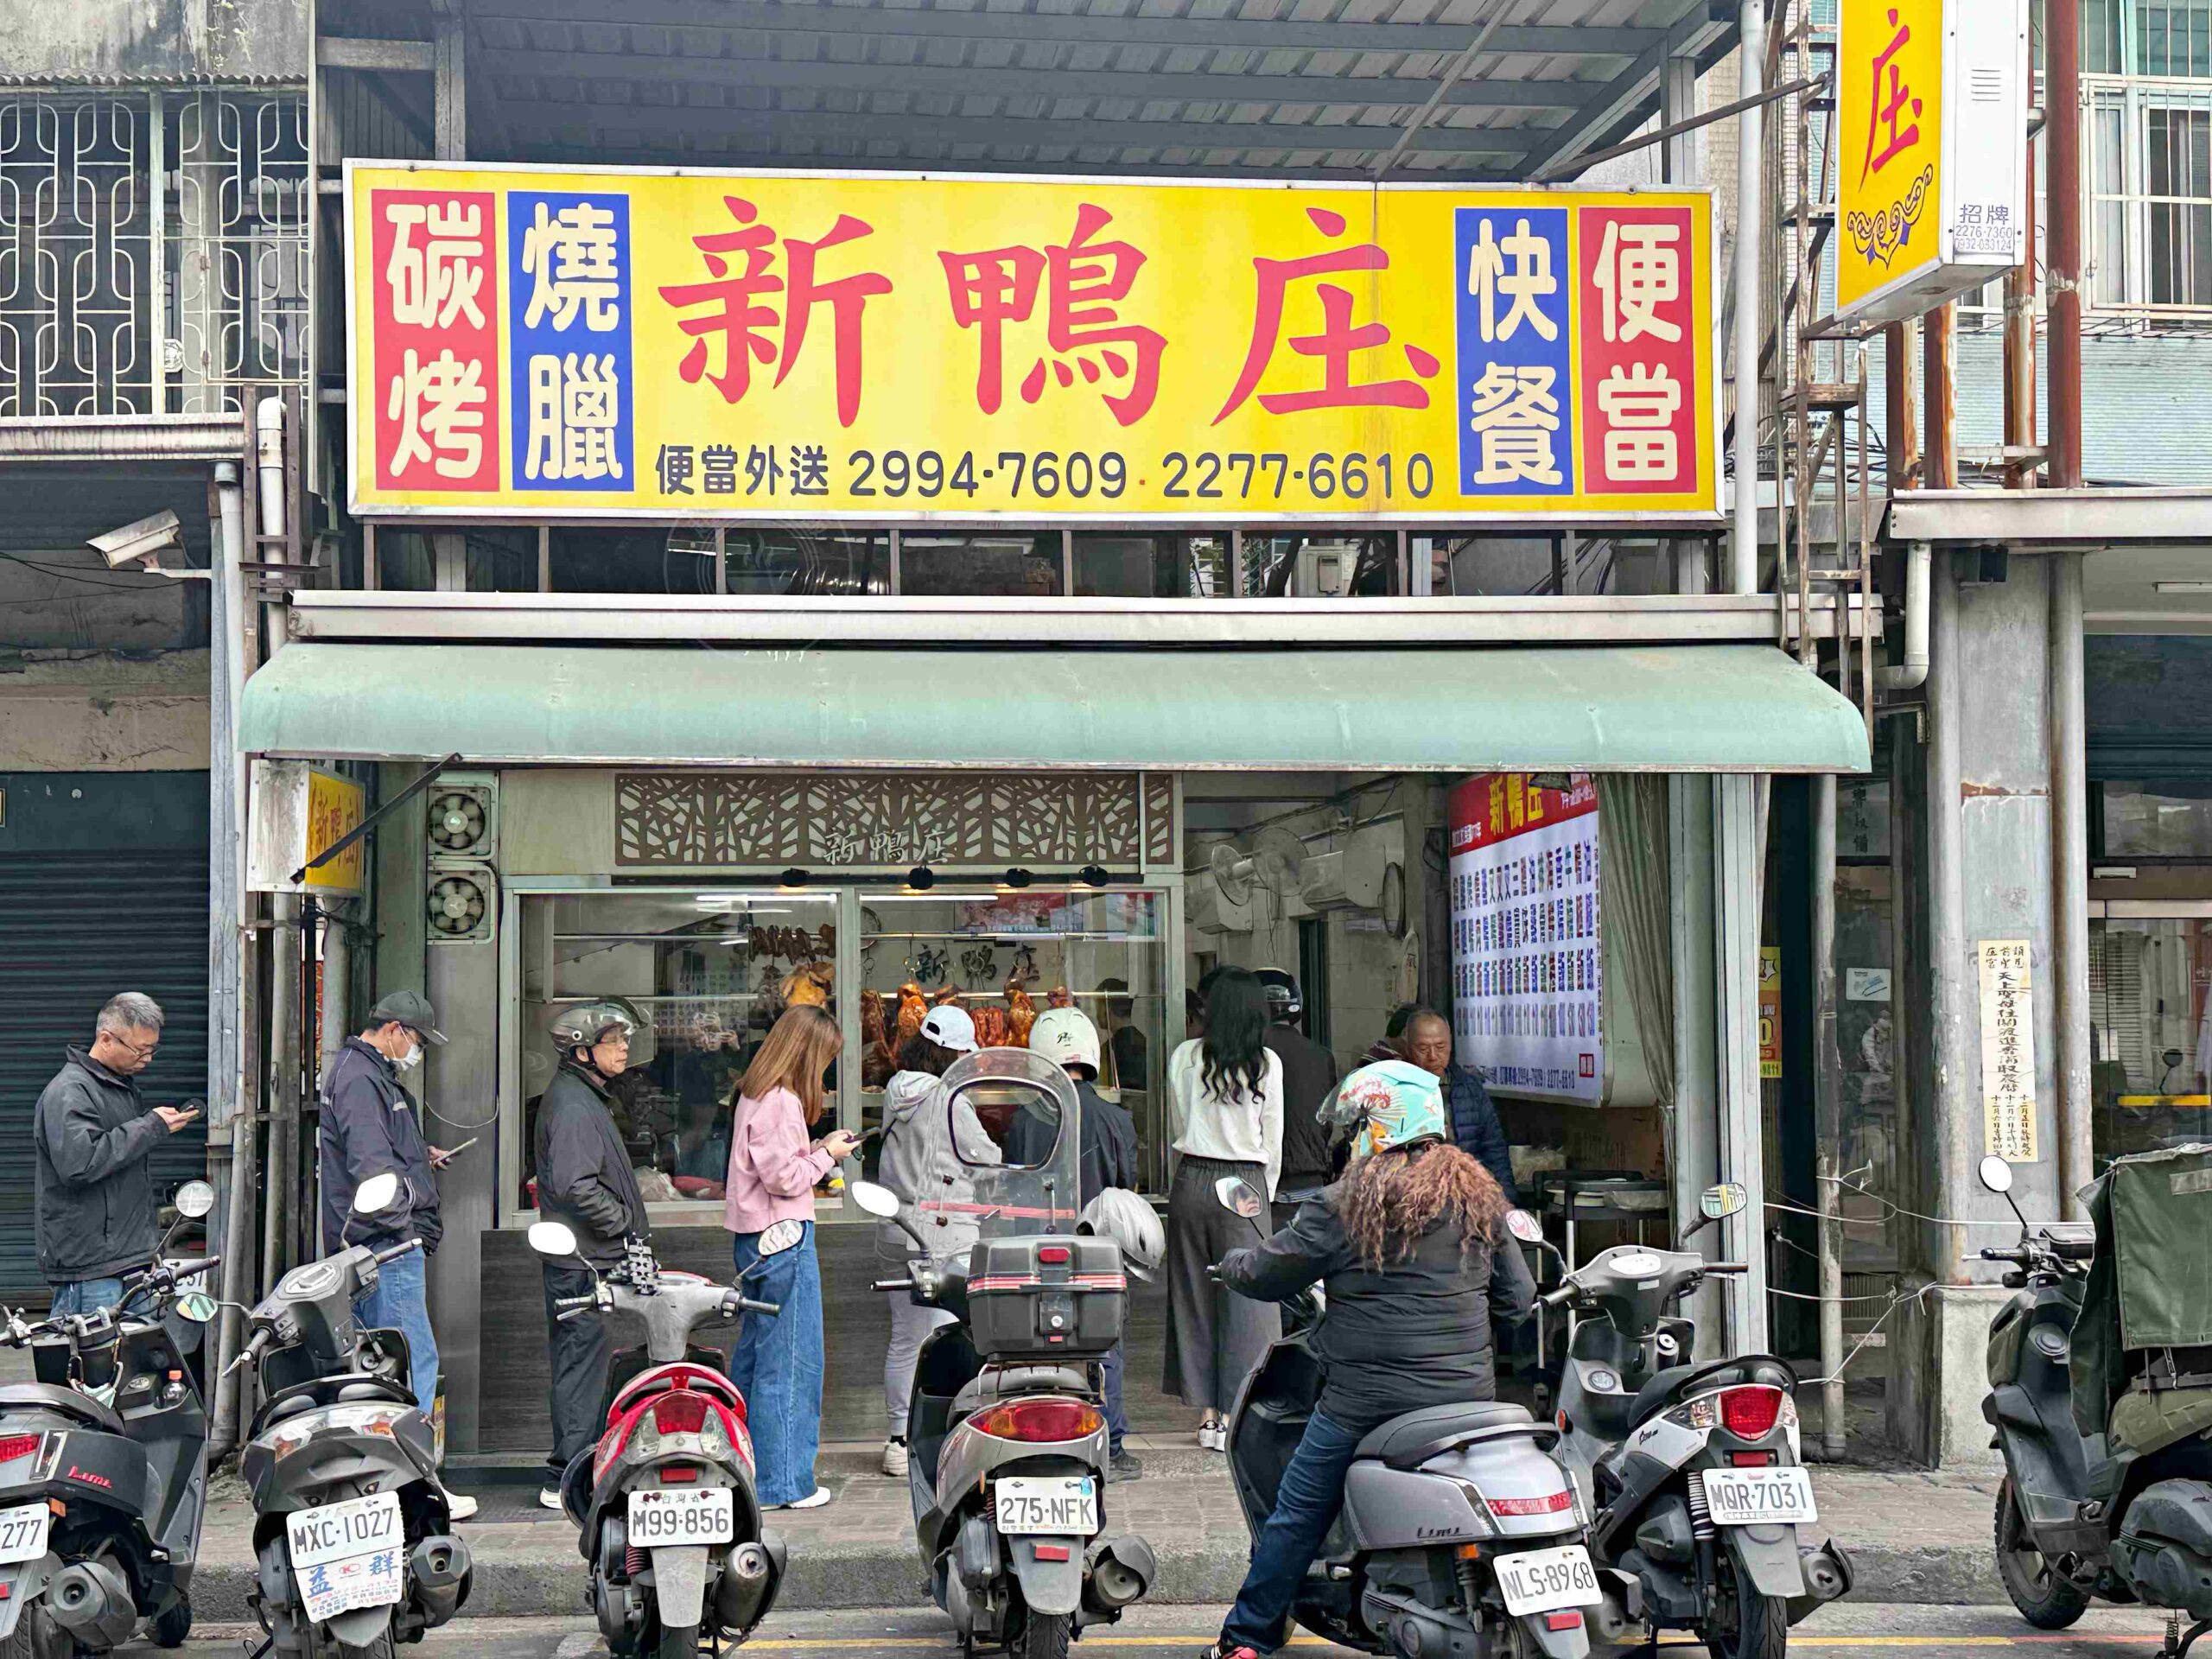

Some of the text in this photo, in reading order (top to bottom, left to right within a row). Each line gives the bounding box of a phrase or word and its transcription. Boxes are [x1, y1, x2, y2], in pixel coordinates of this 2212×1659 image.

[386, 200, 487, 479] 碳烤
[521, 201, 623, 481] 燒臘
[658, 195, 1441, 429] 新鴨庄
[1959, 203, 2009, 225] 招牌
[655, 443, 830, 497] 便當外送
[1468, 218, 1563, 486] 快餐
[1592, 219, 1682, 482] 便當
